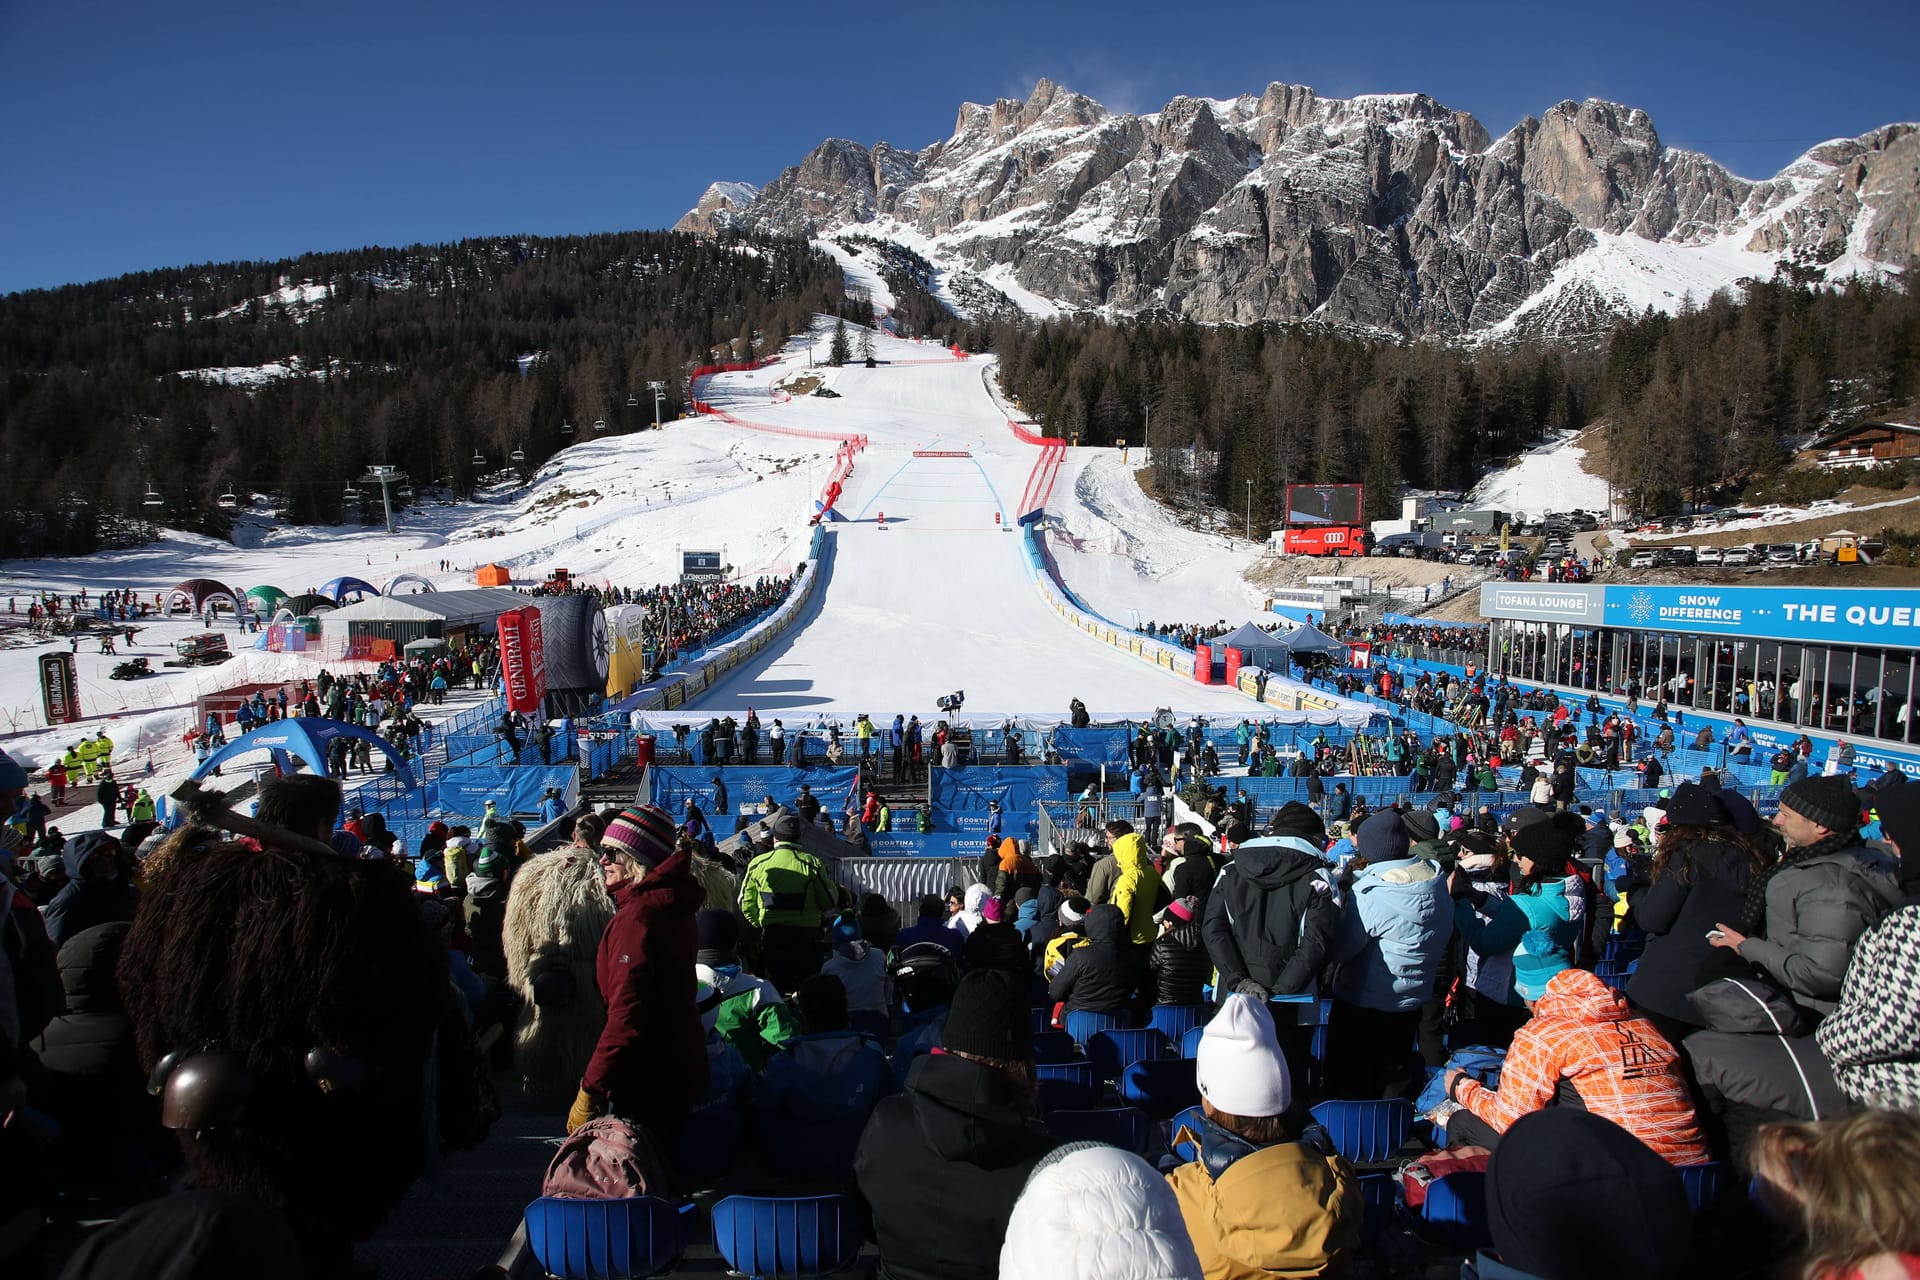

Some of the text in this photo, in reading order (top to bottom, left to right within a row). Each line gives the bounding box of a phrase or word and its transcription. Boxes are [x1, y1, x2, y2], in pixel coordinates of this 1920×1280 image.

[1500, 594, 1583, 609] TOFANA LOUNGE
[1678, 595, 1721, 606] SNOW
[1659, 606, 1742, 621] DIFFERENCE
[1782, 603, 1837, 623] THE
[504, 626, 527, 700] GENERALI
[1752, 732, 1776, 742] SNOW
